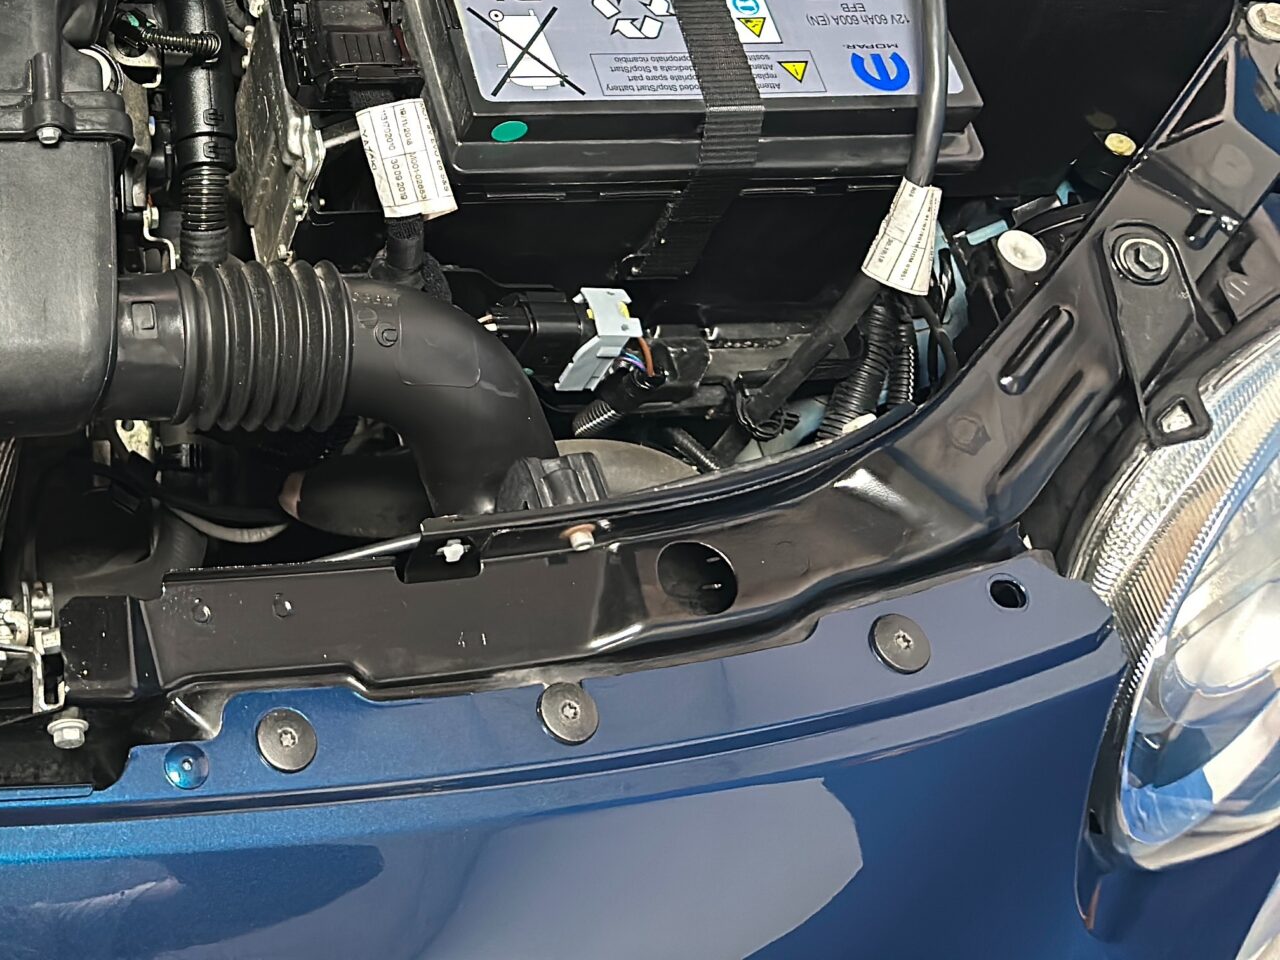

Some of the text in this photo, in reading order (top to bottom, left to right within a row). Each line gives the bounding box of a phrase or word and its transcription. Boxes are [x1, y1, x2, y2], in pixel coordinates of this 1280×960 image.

[842, 2, 866, 13] EFB
[806, 13, 910, 26] 12V 60Ah 600A (EN)
[614, 55, 649, 64] ricambio
[610, 65, 652, 74] Stop/Start
[627, 74, 645, 83] part
[646, 74, 668, 82] spare
[606, 83, 632, 92] battery
[633, 83, 678, 92] Stop/Start
[756, 82, 781, 90] Attent
